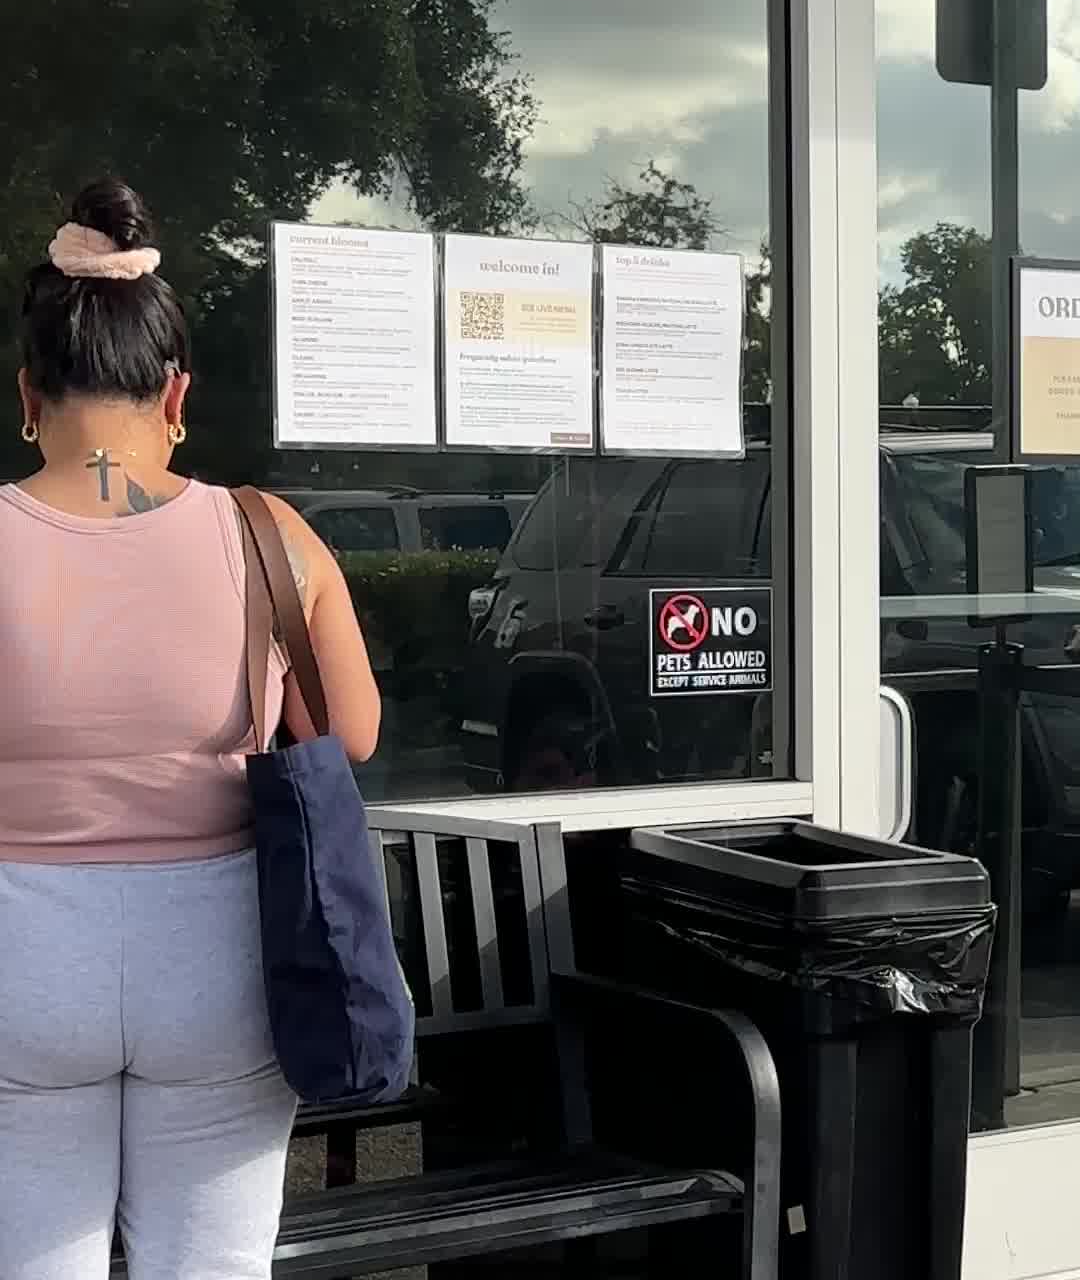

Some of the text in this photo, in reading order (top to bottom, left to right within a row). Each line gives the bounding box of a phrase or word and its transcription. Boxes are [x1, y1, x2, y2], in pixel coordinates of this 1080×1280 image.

[480, 259, 540, 275] welcome
[711, 606, 757, 636] NO
[657, 650, 766, 672] PETS ALLOWED
[657, 676, 689, 688] EXCEPT
